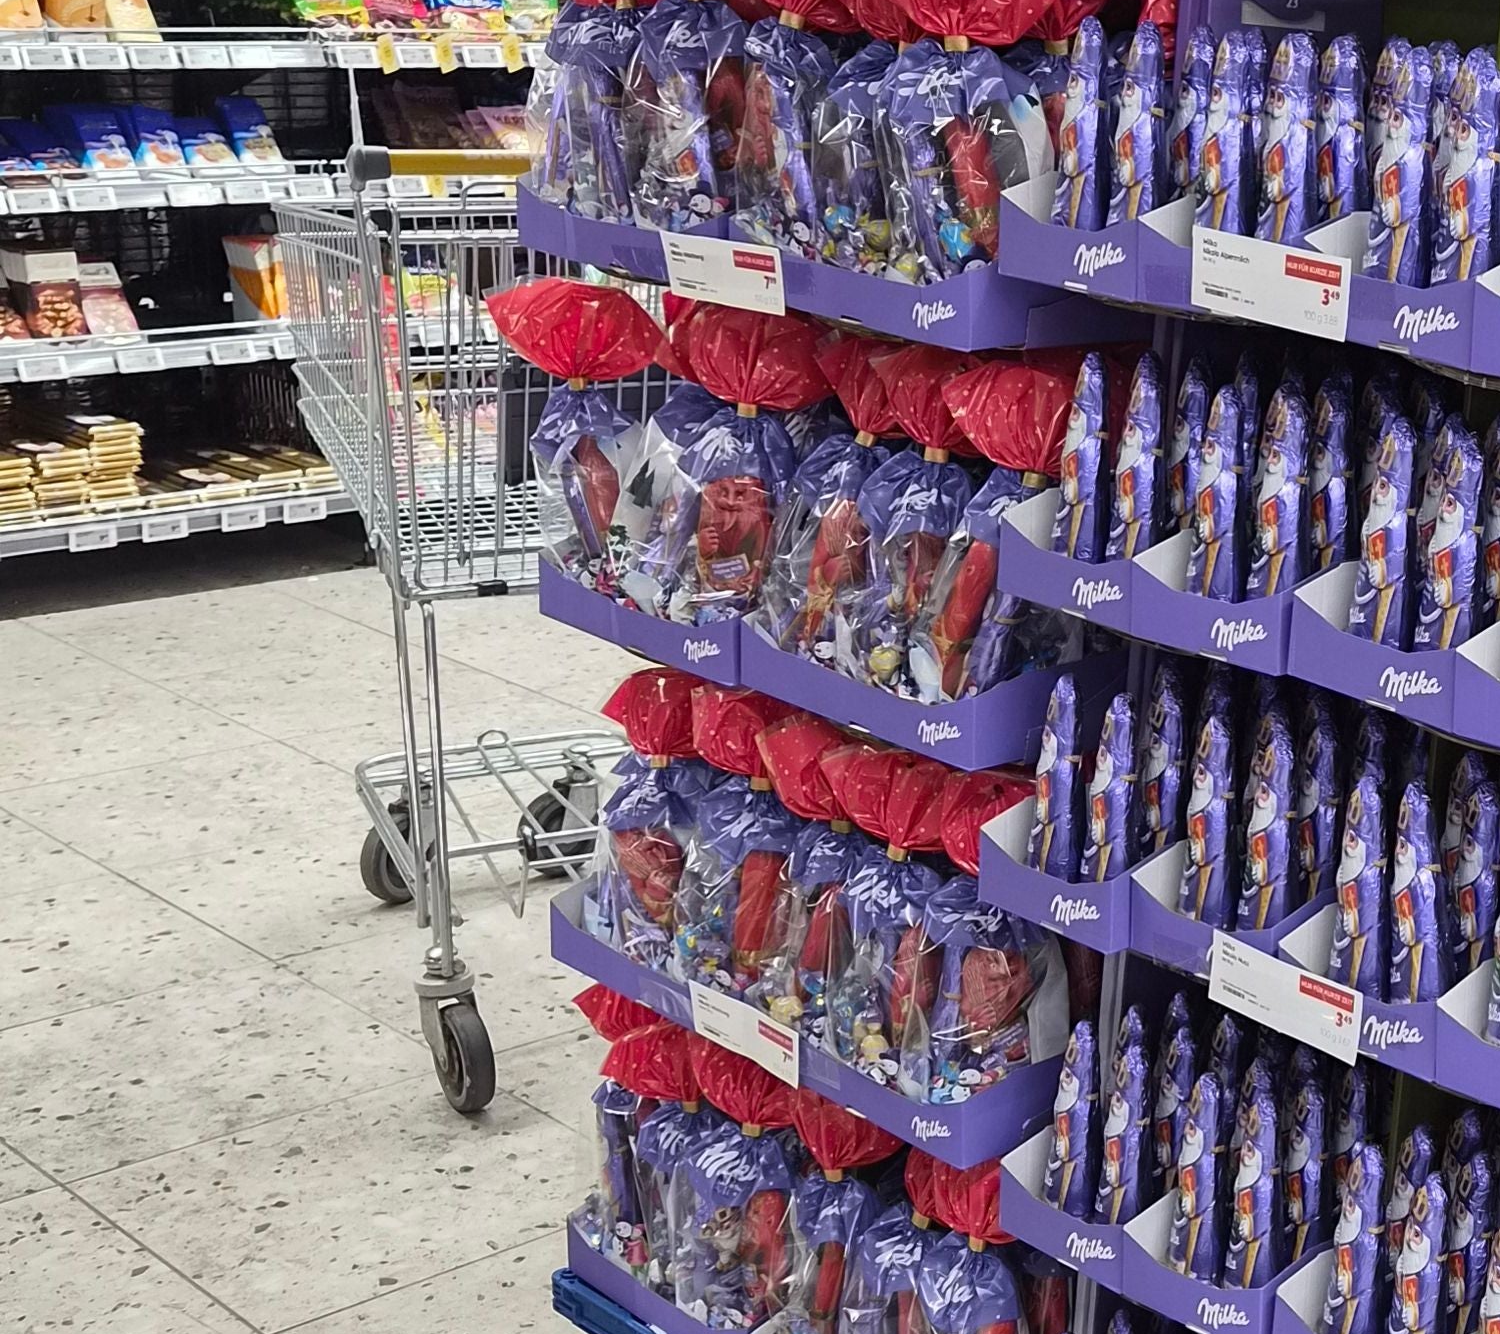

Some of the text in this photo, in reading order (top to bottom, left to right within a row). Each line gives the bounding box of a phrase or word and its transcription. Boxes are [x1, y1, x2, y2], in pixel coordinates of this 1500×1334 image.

[1074, 242, 1126, 277] Milka
[911, 300, 957, 331] Milka
[1394, 305, 1460, 342] Milka
[1072, 577, 1123, 610] Milka
[683, 638, 721, 663] Milka
[1211, 618, 1268, 651] Milka
[1380, 666, 1442, 702] Milka
[917, 719, 962, 746] Milka
[1050, 894, 1100, 927] Milka
[1363, 1015, 1423, 1051] Milka
[911, 1115, 952, 1141] Milka
[1066, 1232, 1116, 1262] Milka
[1197, 1298, 1250, 1329] Milka
